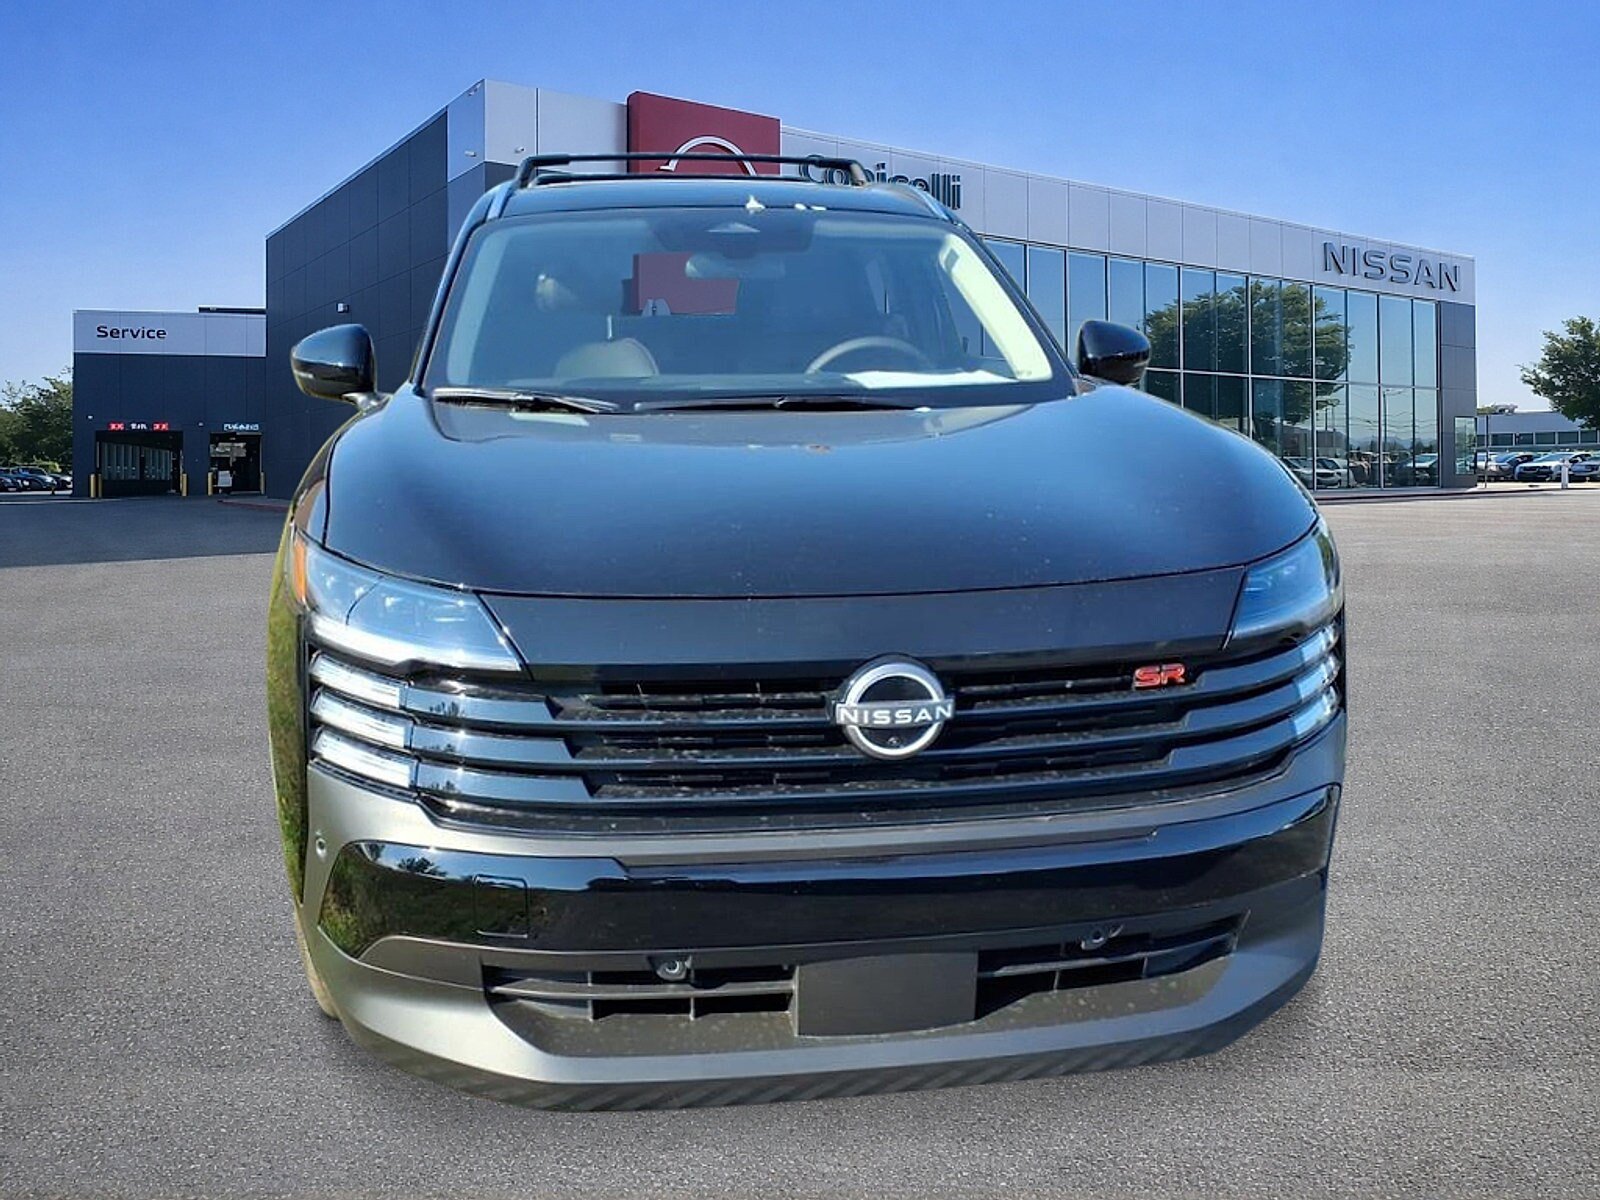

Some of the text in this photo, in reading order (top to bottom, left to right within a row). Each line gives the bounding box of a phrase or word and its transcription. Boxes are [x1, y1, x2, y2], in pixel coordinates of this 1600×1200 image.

[1323, 242, 1461, 292] NISSAN
[96, 325, 167, 339] Service
[1133, 663, 1185, 688] SR
[840, 703, 953, 725] NISSAN
